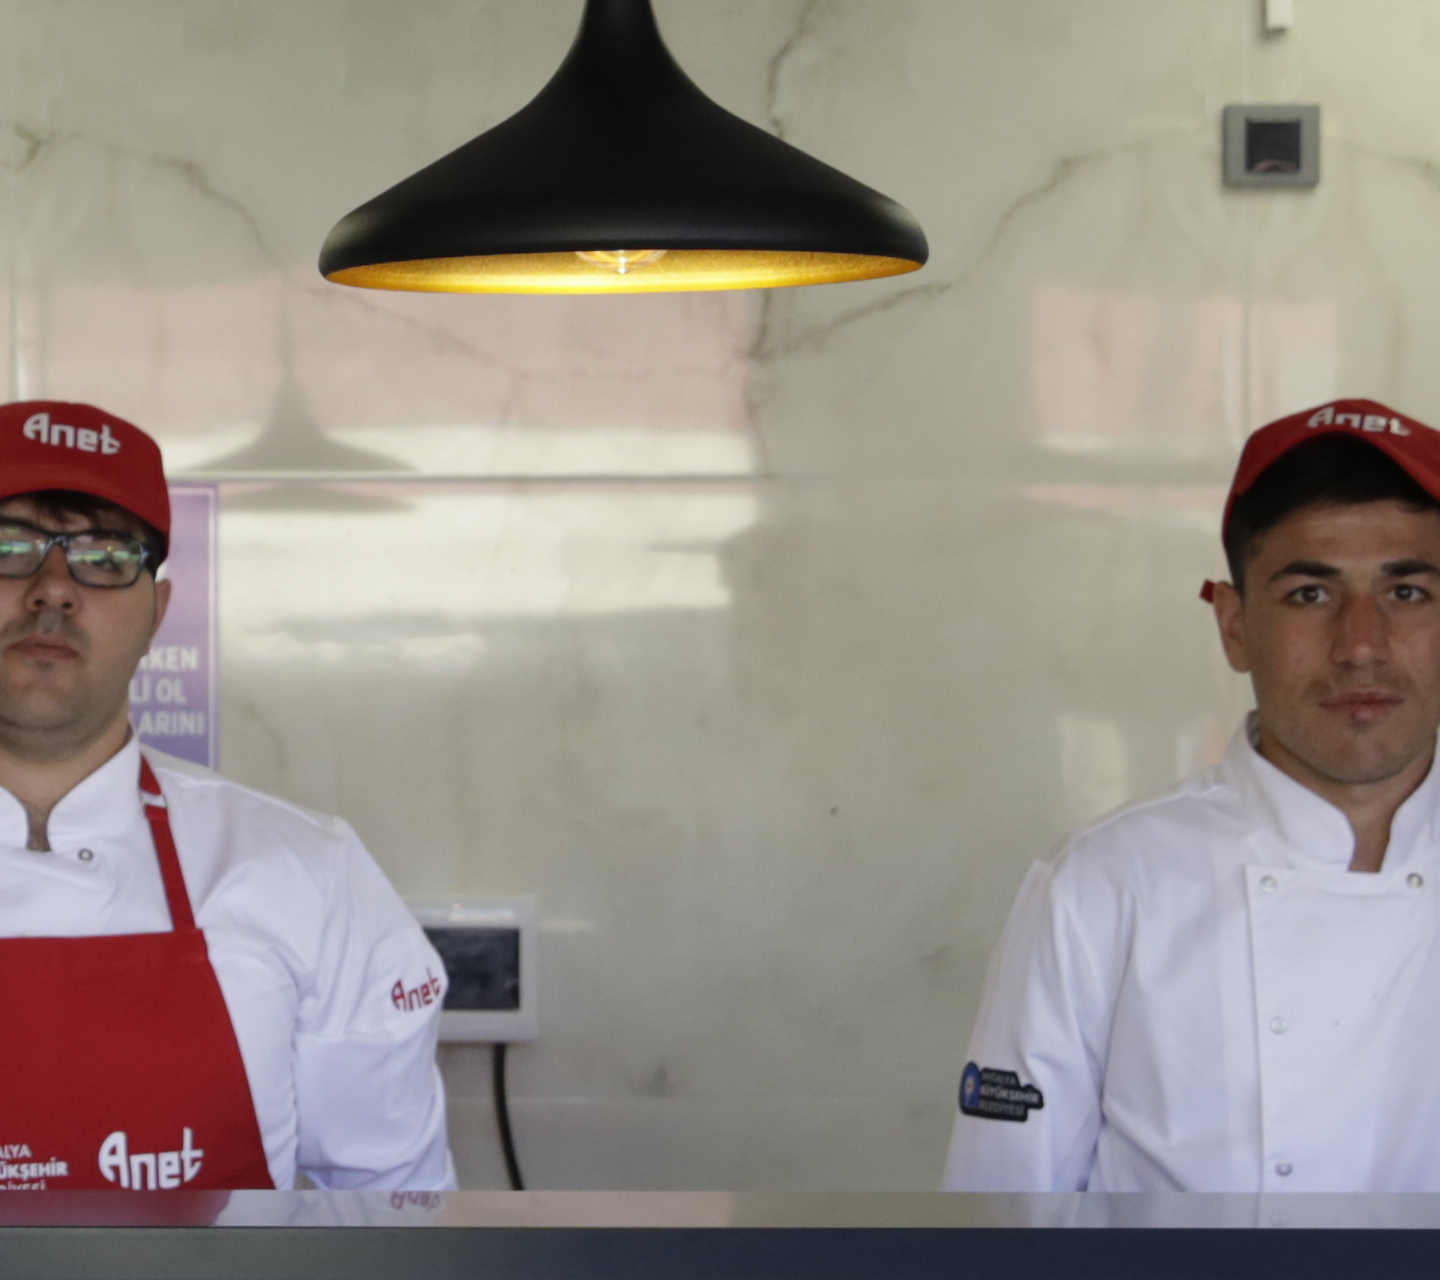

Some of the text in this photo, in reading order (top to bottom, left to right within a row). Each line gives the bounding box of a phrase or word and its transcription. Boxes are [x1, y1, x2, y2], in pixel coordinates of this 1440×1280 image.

[23, 412, 120, 454] Anet
[1307, 406, 1412, 437] Anet
[391, 966, 441, 1011] Anet
[98, 1127, 204, 1190] Anet
